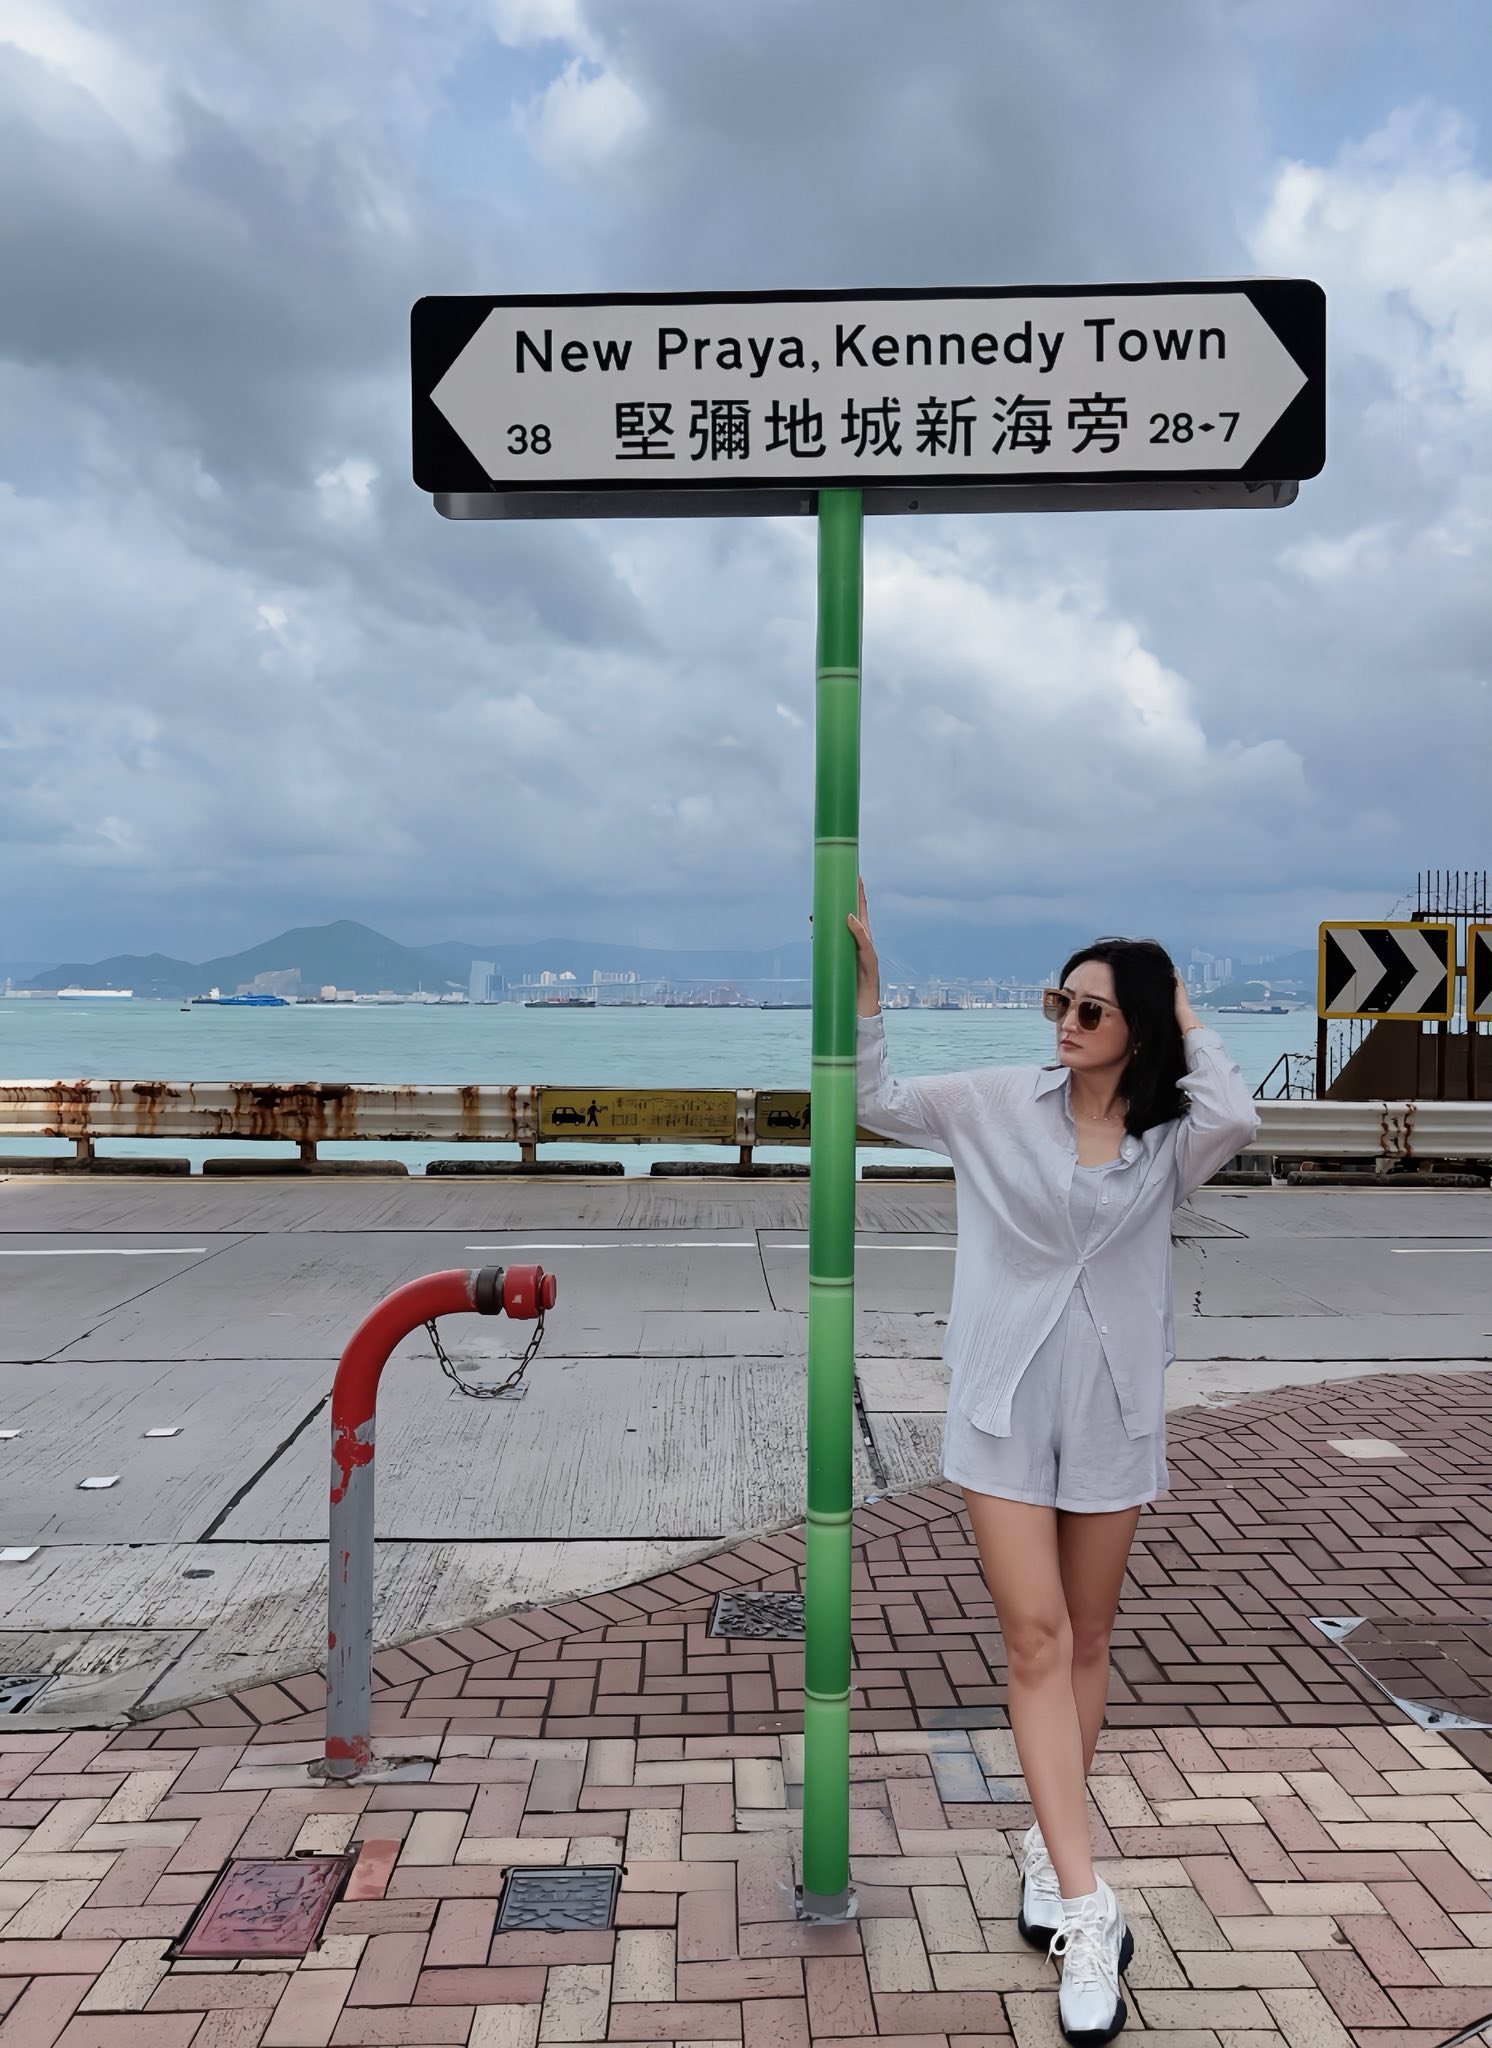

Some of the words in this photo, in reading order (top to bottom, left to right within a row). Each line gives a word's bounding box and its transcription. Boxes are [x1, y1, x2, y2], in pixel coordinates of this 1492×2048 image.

[516, 329, 633, 374] New
[658, 327, 820, 379] Praya,
[835, 320, 1065, 374] Kennedy
[1083, 317, 1226, 363] Town
[506, 423, 552, 455] 38
[615, 391, 1128, 462] 堅彌地城新海旁
